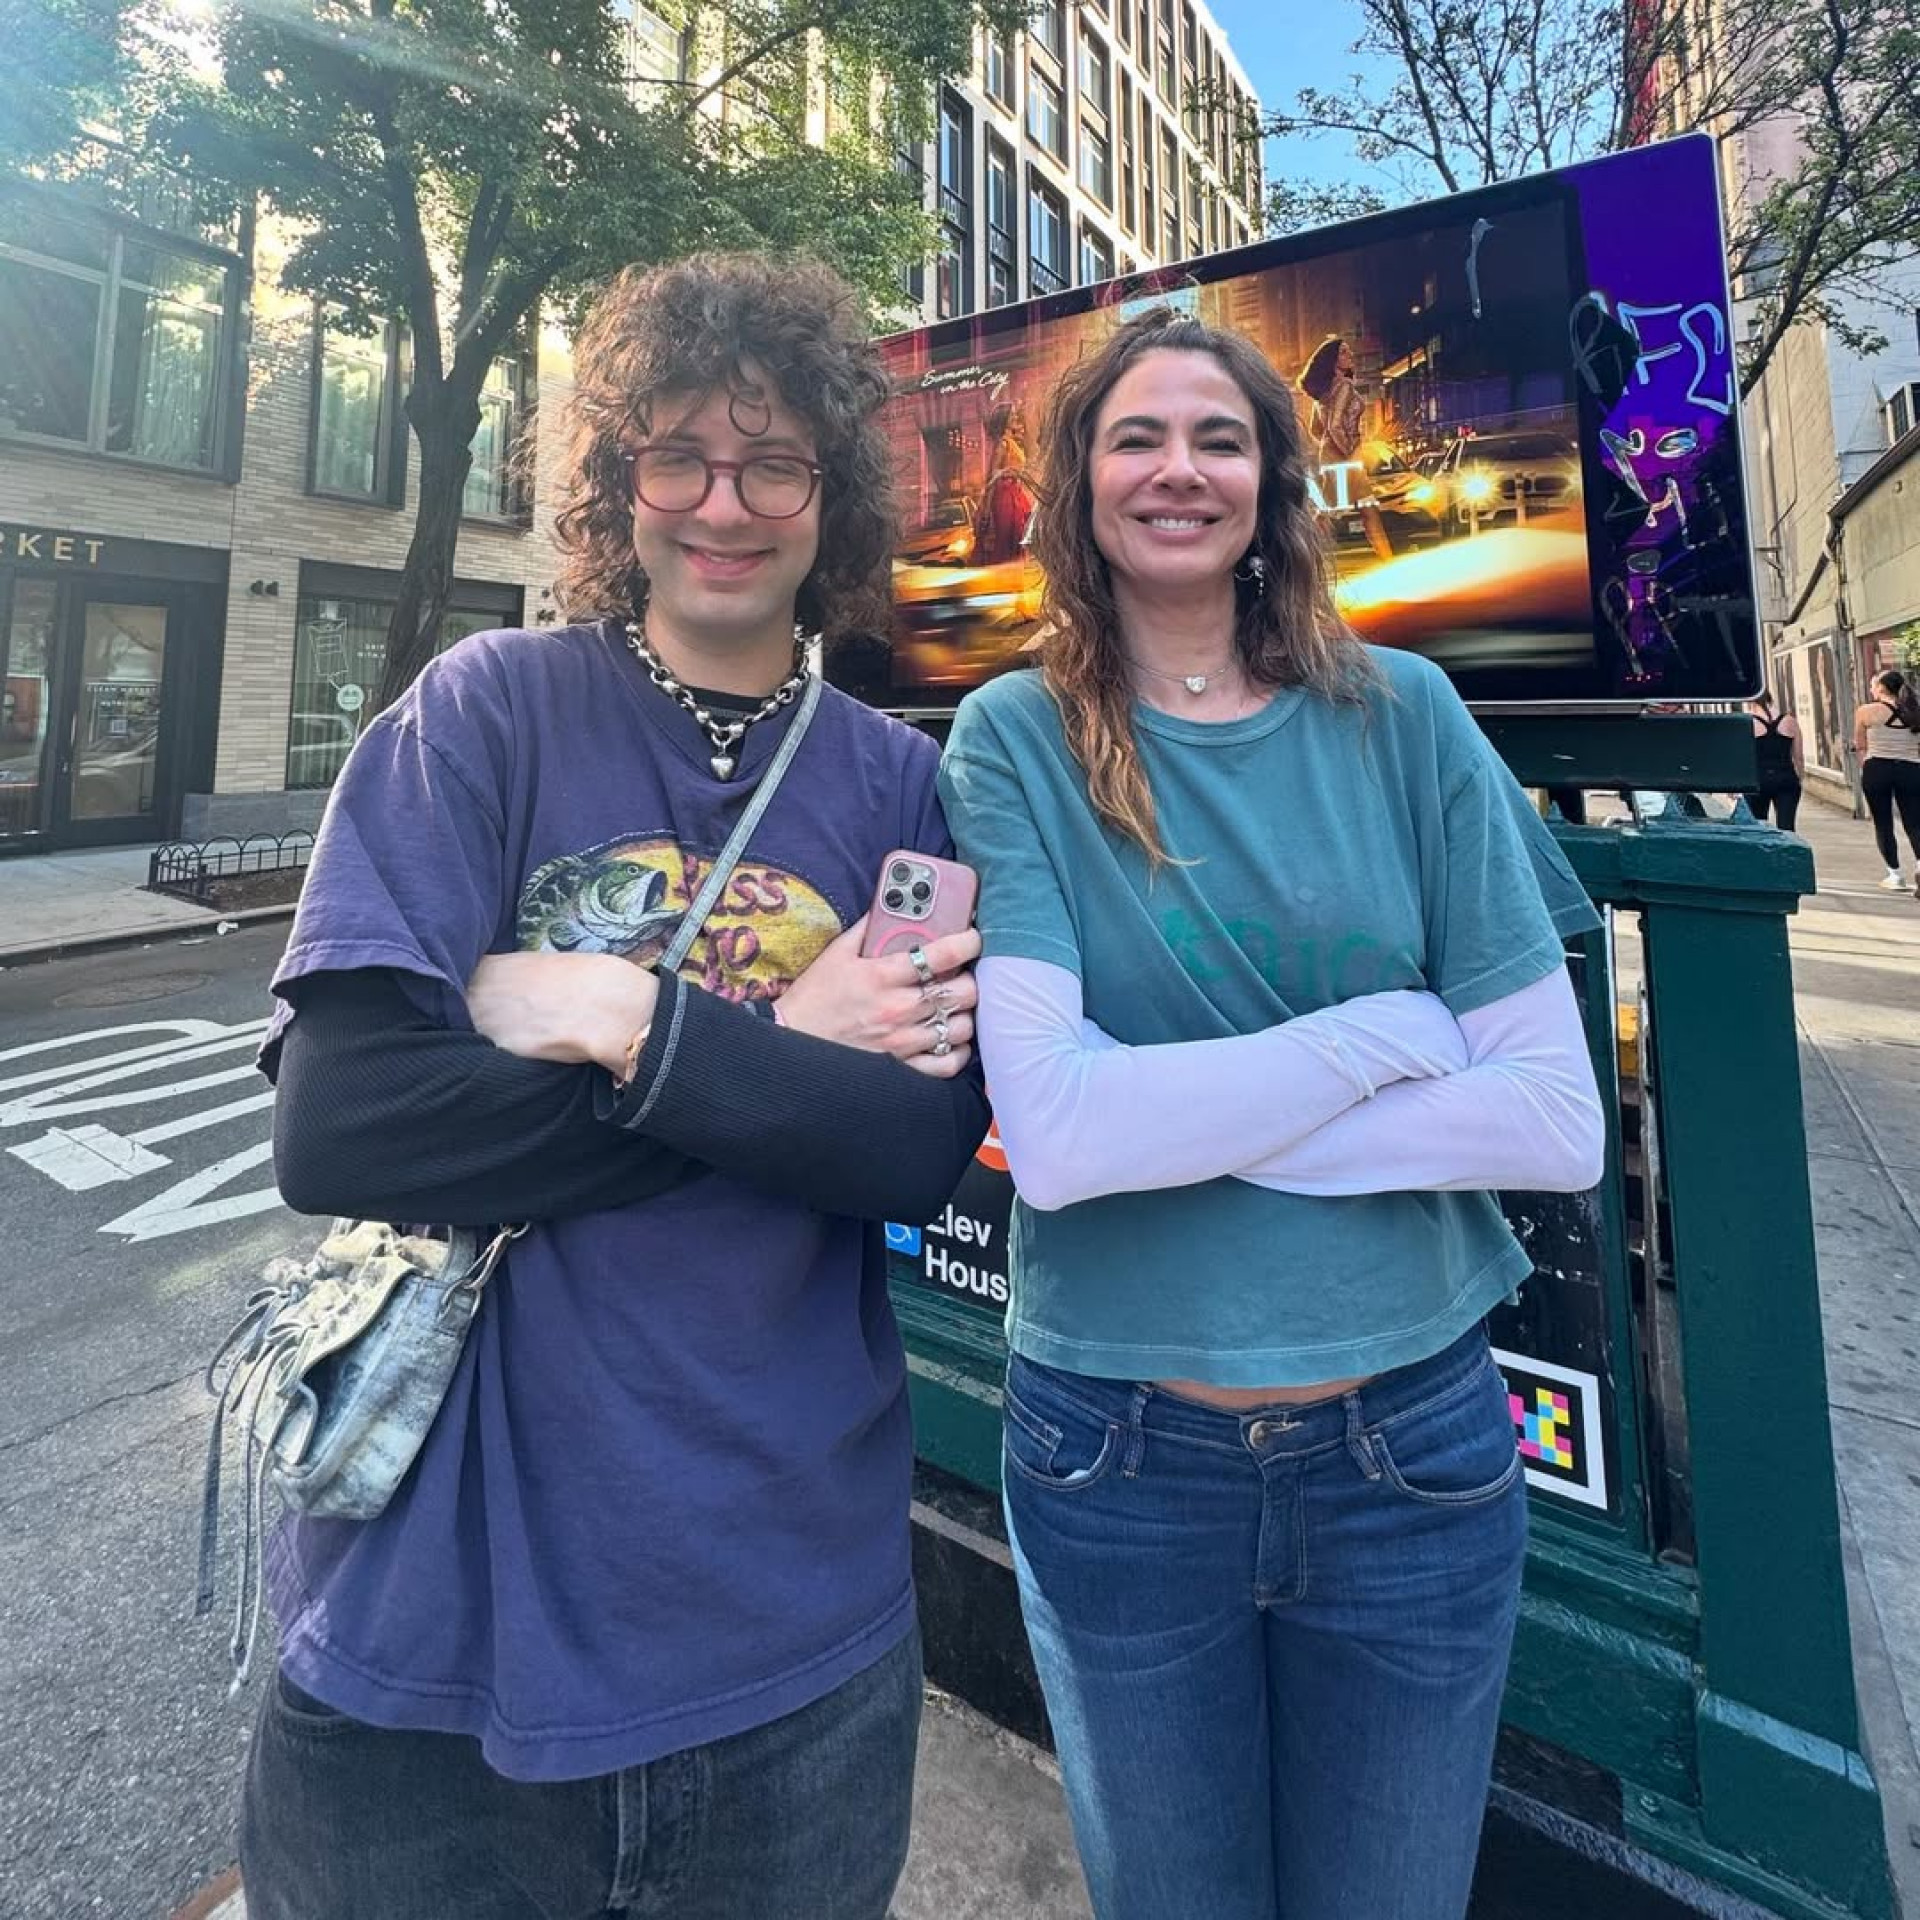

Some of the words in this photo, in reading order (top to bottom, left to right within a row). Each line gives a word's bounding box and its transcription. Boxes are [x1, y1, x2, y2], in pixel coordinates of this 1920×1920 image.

[921, 366, 983, 387] Summer
[978, 372, 1010, 401] City
[0, 532, 104, 564] KET
[925, 1243, 1009, 1302] Hous
